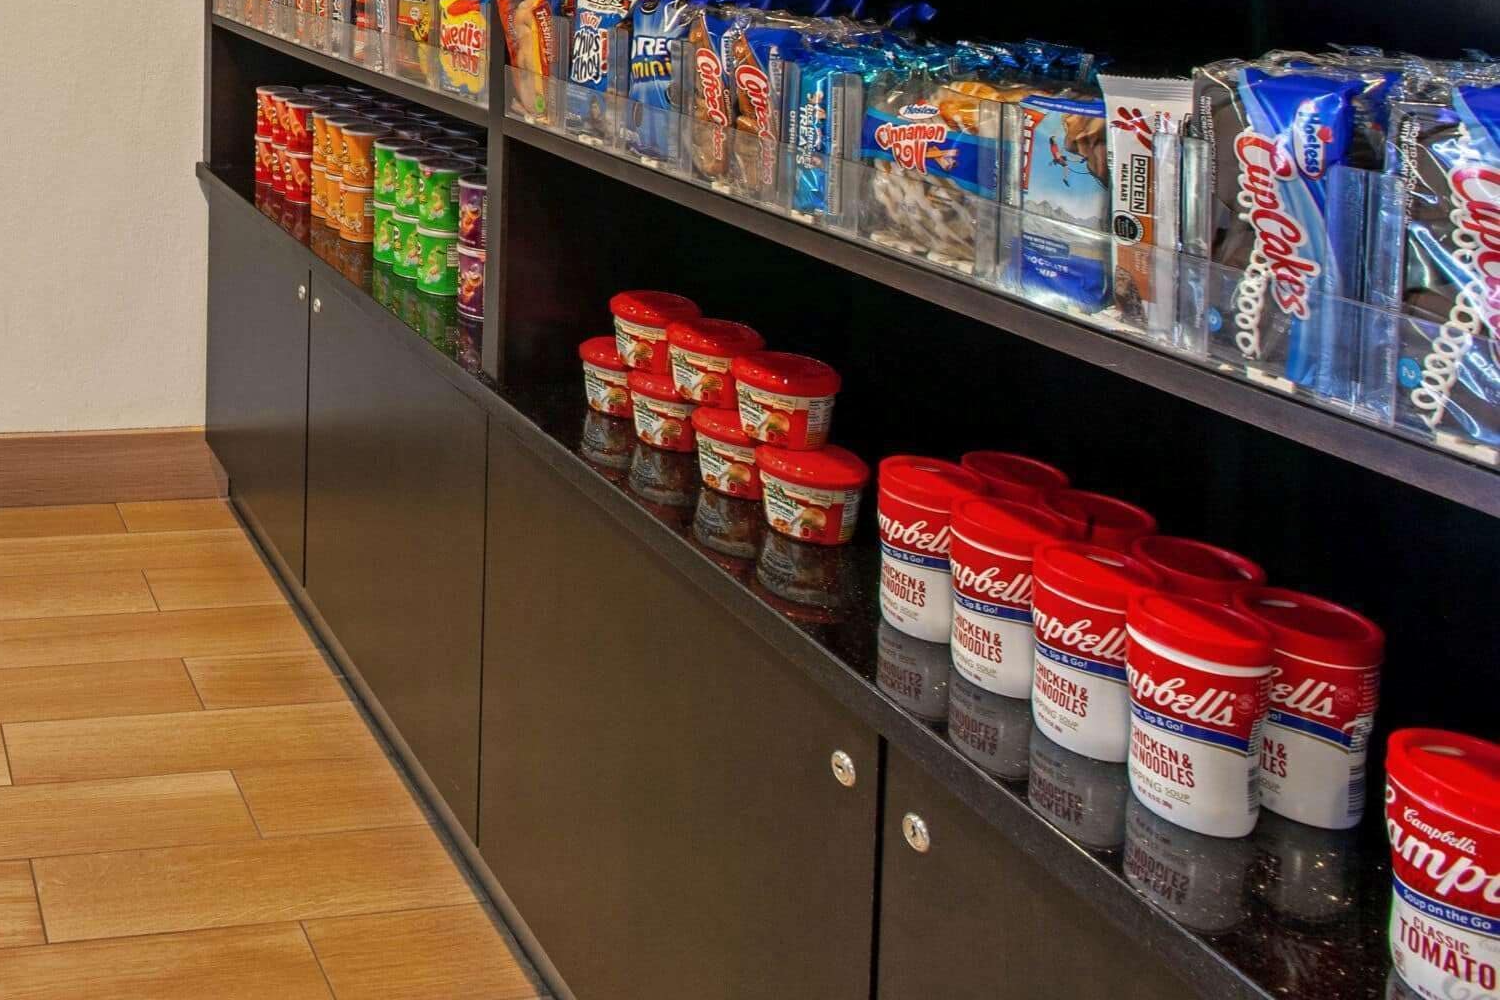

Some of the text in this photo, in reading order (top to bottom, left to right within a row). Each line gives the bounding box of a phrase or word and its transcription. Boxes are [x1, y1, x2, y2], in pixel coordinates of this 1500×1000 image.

[572, 29, 601, 59] Chips
[875, 122, 947, 150] Cinnamon
[891, 140, 927, 174] Roll
[1133, 157, 1147, 211] PROTEIN
[918, 580, 926, 593] &
[993, 632, 1003, 648] &
[1070, 657, 1089, 669] Go!
[1079, 686, 1089, 702] &
[1165, 719, 1184, 732] Go!
[1138, 744, 1196, 788] NOODLES
[1181, 753, 1193, 770] &
[1402, 889, 1492, 931] Soup on the Go
[1412, 915, 1471, 956] CLASSIC
[1400, 916, 1497, 992] TOMATO
